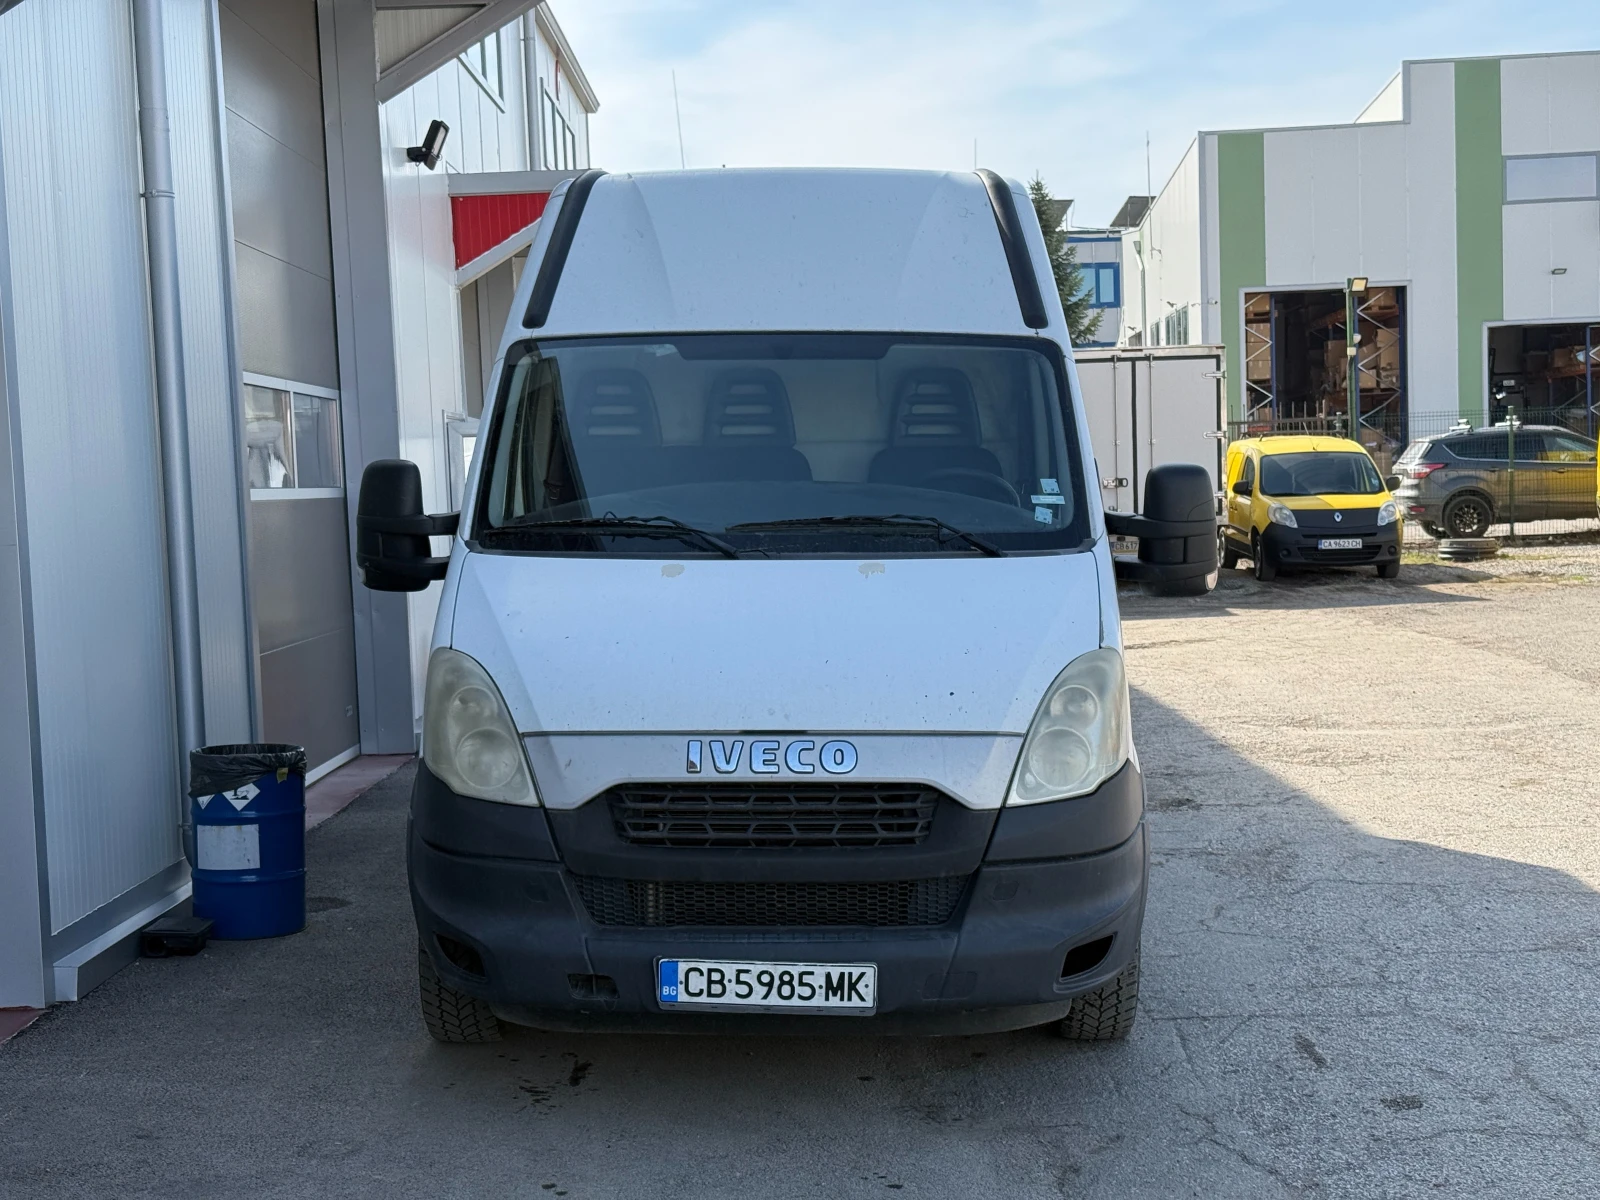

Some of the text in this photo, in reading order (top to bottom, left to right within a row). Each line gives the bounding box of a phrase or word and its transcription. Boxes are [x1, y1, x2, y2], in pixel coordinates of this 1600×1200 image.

[1322, 540, 1333, 548] CA
[1333, 540, 1351, 548] 9623
[687, 740, 858, 774] IVECO
[662, 966, 867, 1002] BG CB 5985 MK
